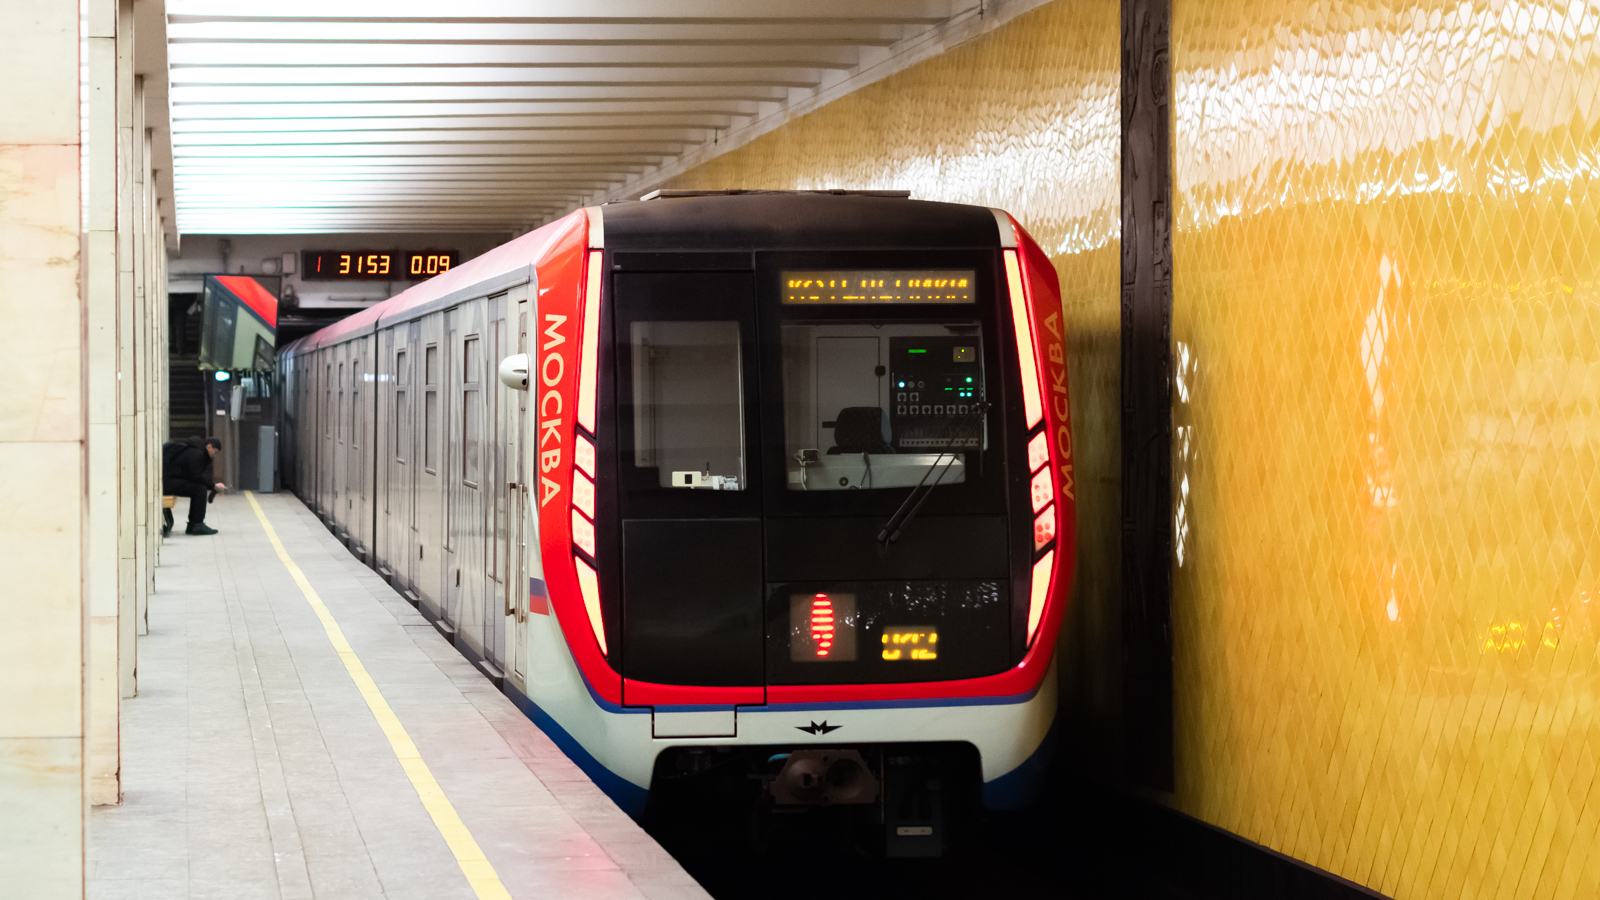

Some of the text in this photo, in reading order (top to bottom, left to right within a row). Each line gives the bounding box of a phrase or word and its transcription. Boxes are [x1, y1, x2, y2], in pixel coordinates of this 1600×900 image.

[339, 255, 391, 274] 3153
[410, 255, 451, 274] 0.09
[541, 313, 568, 508] МОСКВА
[1043, 310, 1075, 502] МОСКВА
